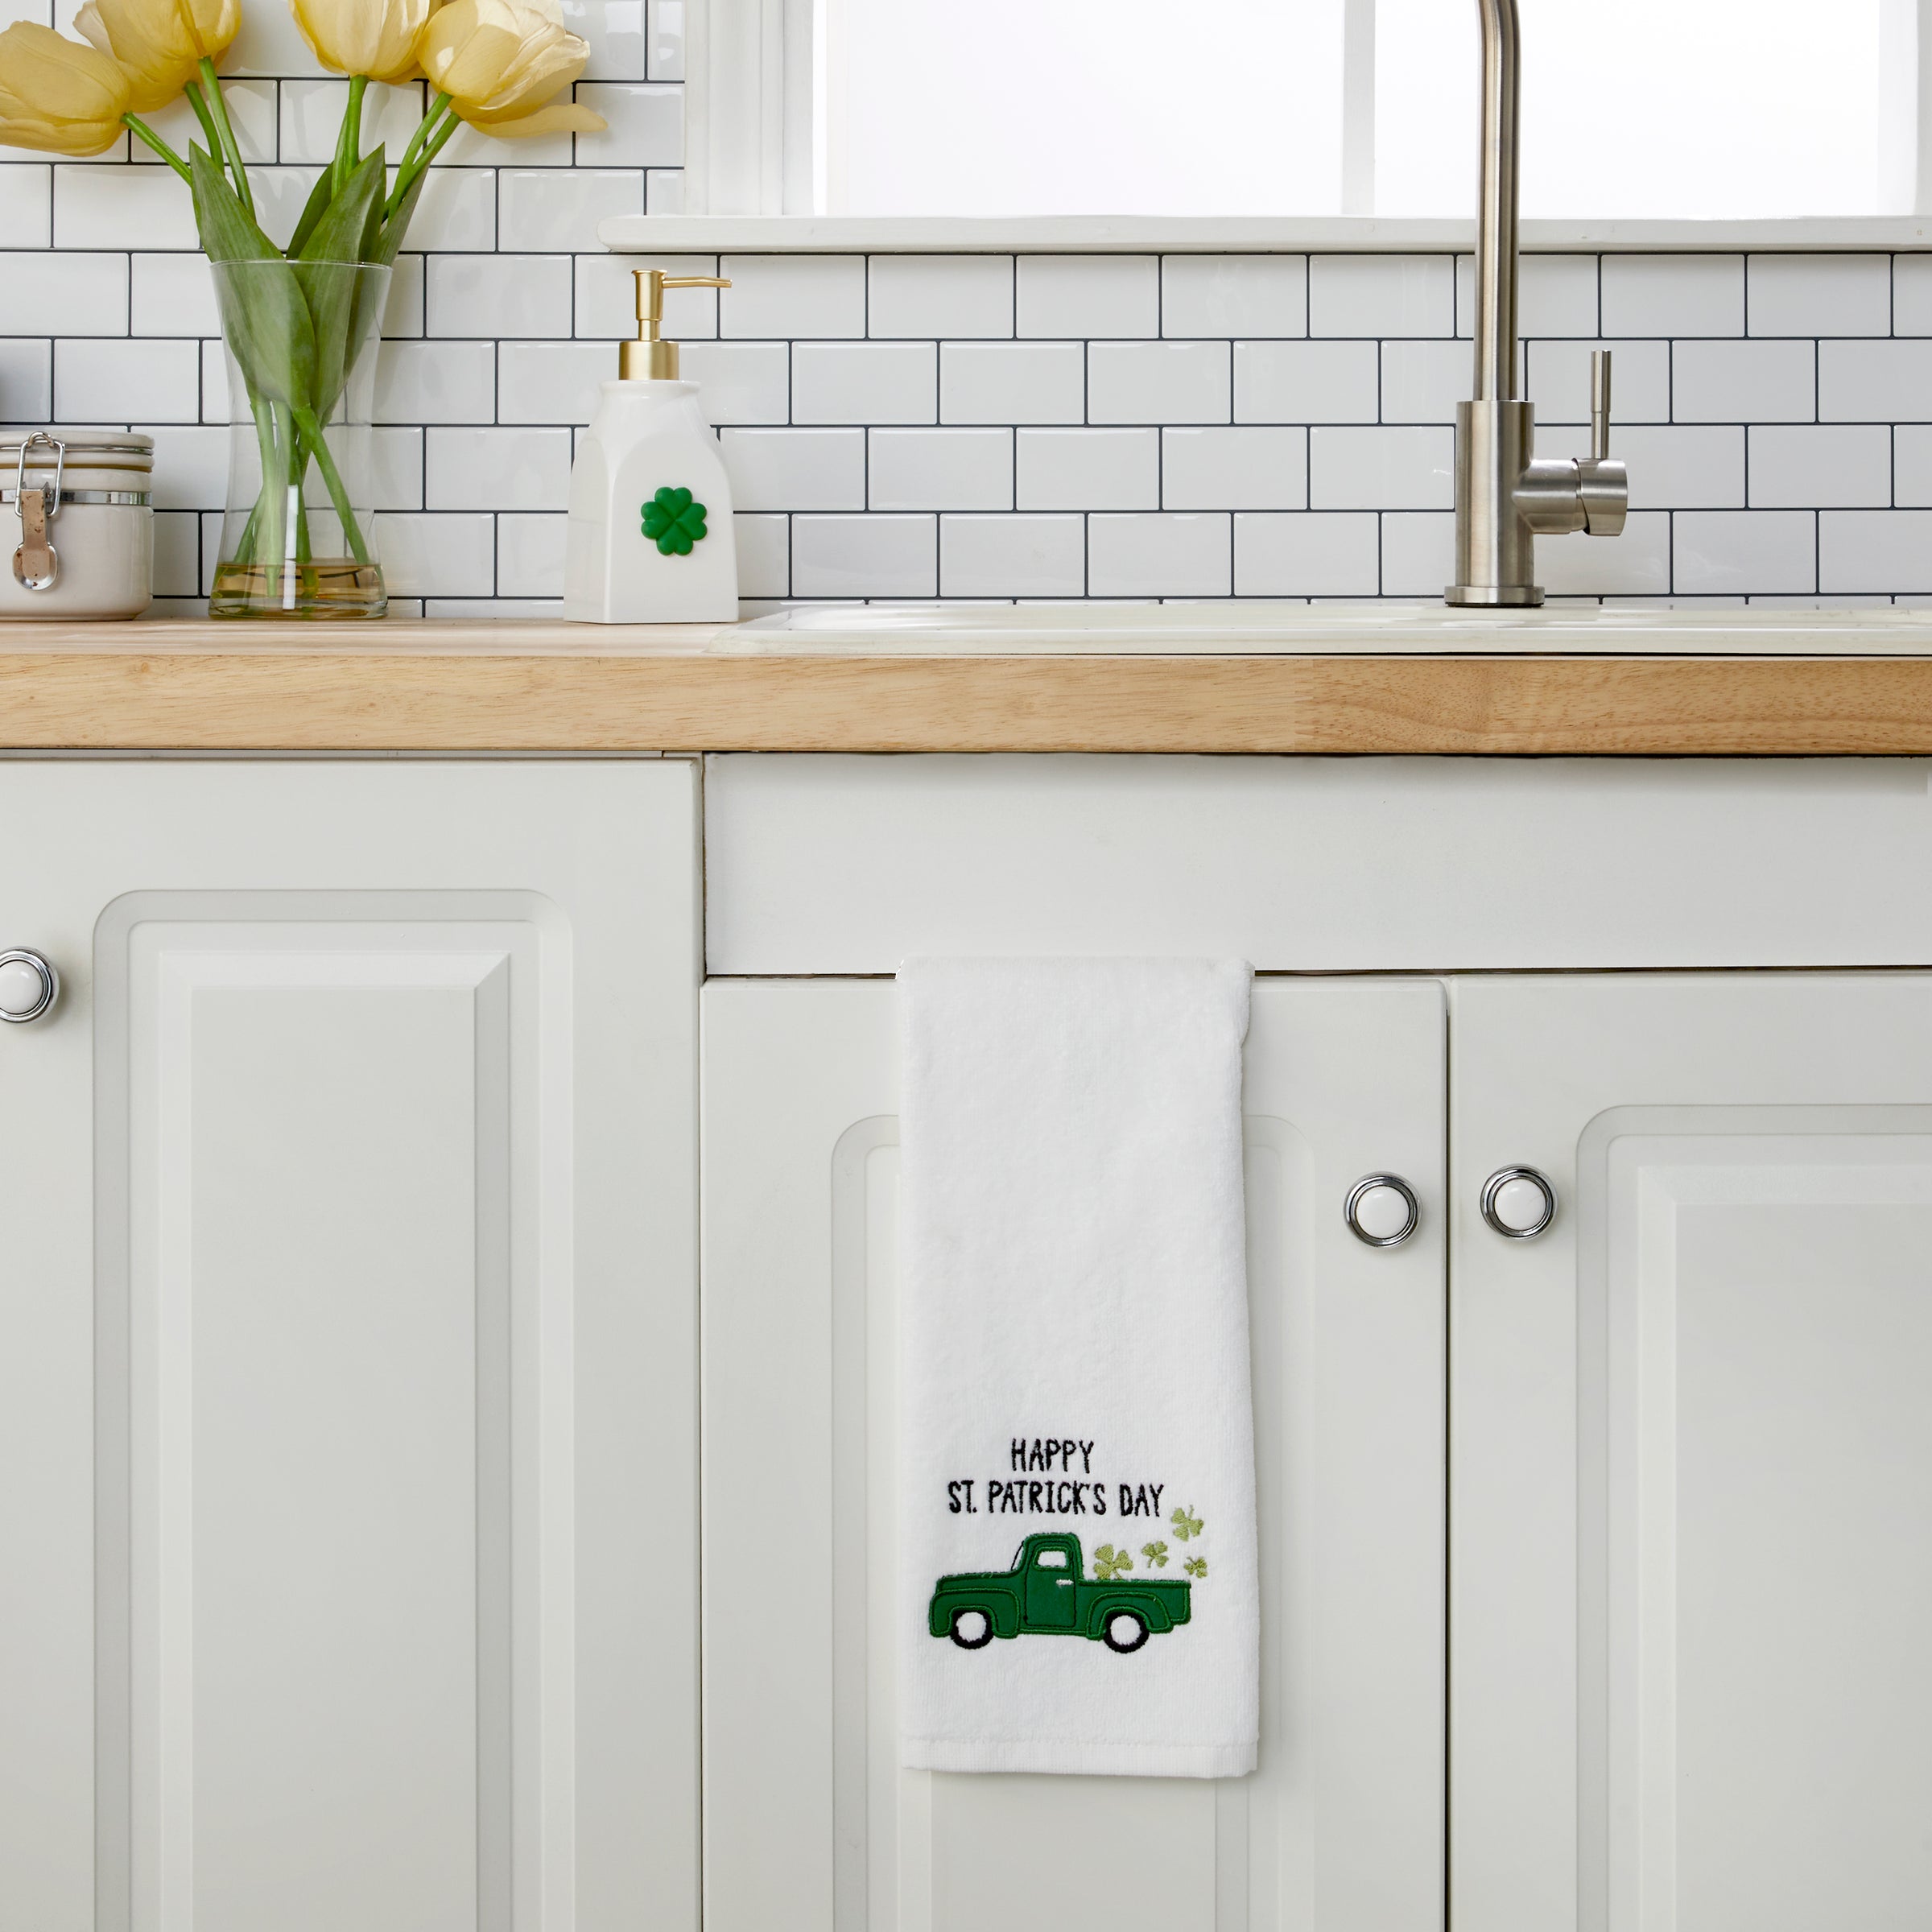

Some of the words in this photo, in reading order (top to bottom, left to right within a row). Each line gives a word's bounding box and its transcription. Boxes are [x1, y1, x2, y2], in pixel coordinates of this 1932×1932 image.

[1011, 1438, 1094, 1474] HAPPY
[947, 1480, 977, 1514] ST.
[989, 1480, 1107, 1516] PATRICK'S
[1120, 1484, 1165, 1517] DAY
